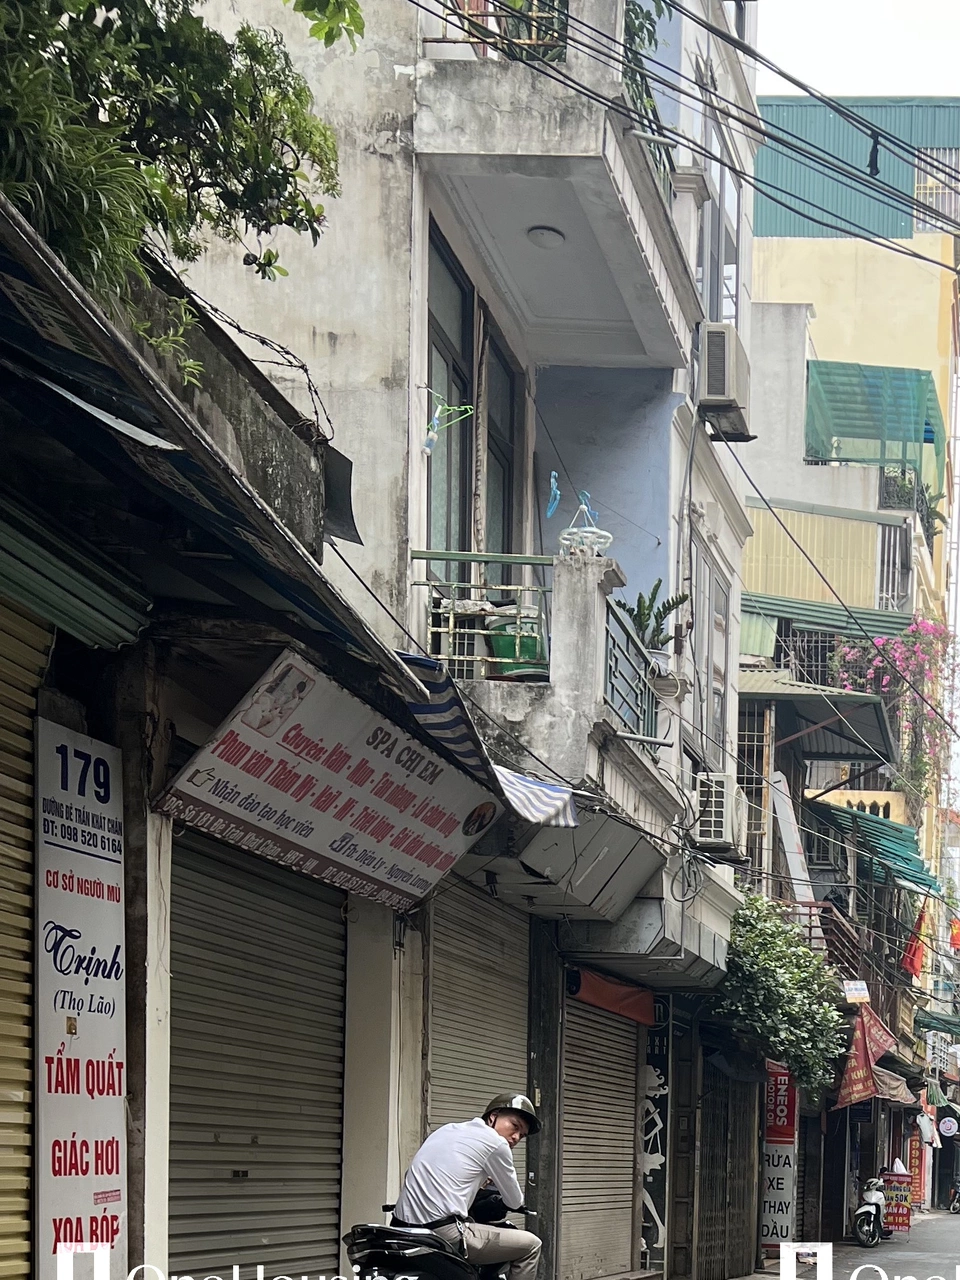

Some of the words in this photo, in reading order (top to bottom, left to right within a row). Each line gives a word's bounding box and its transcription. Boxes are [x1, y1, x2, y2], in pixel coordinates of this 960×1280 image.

[209, 728, 252, 767] Phun
[238, 749, 275, 779] xăm
[262, 758, 302, 794] Thẩm
[289, 773, 320, 803] Mỹ
[279, 721, 328, 762] Chuyên:
[319, 742, 352, 774] Nám
[345, 757, 375, 788] Mụn
[363, 724, 403, 759] SPA
[392, 743, 426, 778] CHỊ
[415, 759, 445, 786] EM
[55, 743, 111, 805] 179
[75, 804, 91, 827] TRẦN
[91, 812, 106, 832] KHÁT
[192, 810, 216, 828] 181
[206, 778, 243, 804] Nhận
[235, 793, 261, 813] đào
[256, 802, 278, 821] tạo
[272, 809, 296, 830] học
[289, 819, 315, 838] viên
[43, 818, 58, 837] ĐT:
[60, 823, 78, 843] 098
[81, 830, 98, 849] 520
[100, 834, 122, 855] 6164
[45, 869, 59, 889] CƠ
[61, 869, 74, 893] SỞ
[77, 876, 104, 900] NGƯỜI
[106, 883, 121, 904] MÙ
[43, 920, 124, 986] Trịnh
[53, 989, 84, 1016] (Thọ
[87, 993, 116, 1019] Lão)
[45, 1041, 81, 1095] TẨM
[85, 1048, 124, 1100] QUẤT
[766, 1076, 775, 1111] MOTOR
[777, 1076, 788, 1126] ENEOS
[766, 1112, 774, 1127] OIL
[51, 1132, 90, 1177] GIÁC
[94, 1136, 120, 1175] HƠI
[767, 1176, 785, 1191] XE
[895, 1193, 908, 1202] 50K
[763, 1201, 791, 1215] THAY
[52, 1217, 84, 1255] XOA
[89, 1207, 120, 1251] BÓP
[761, 1219, 789, 1238] DẦU
